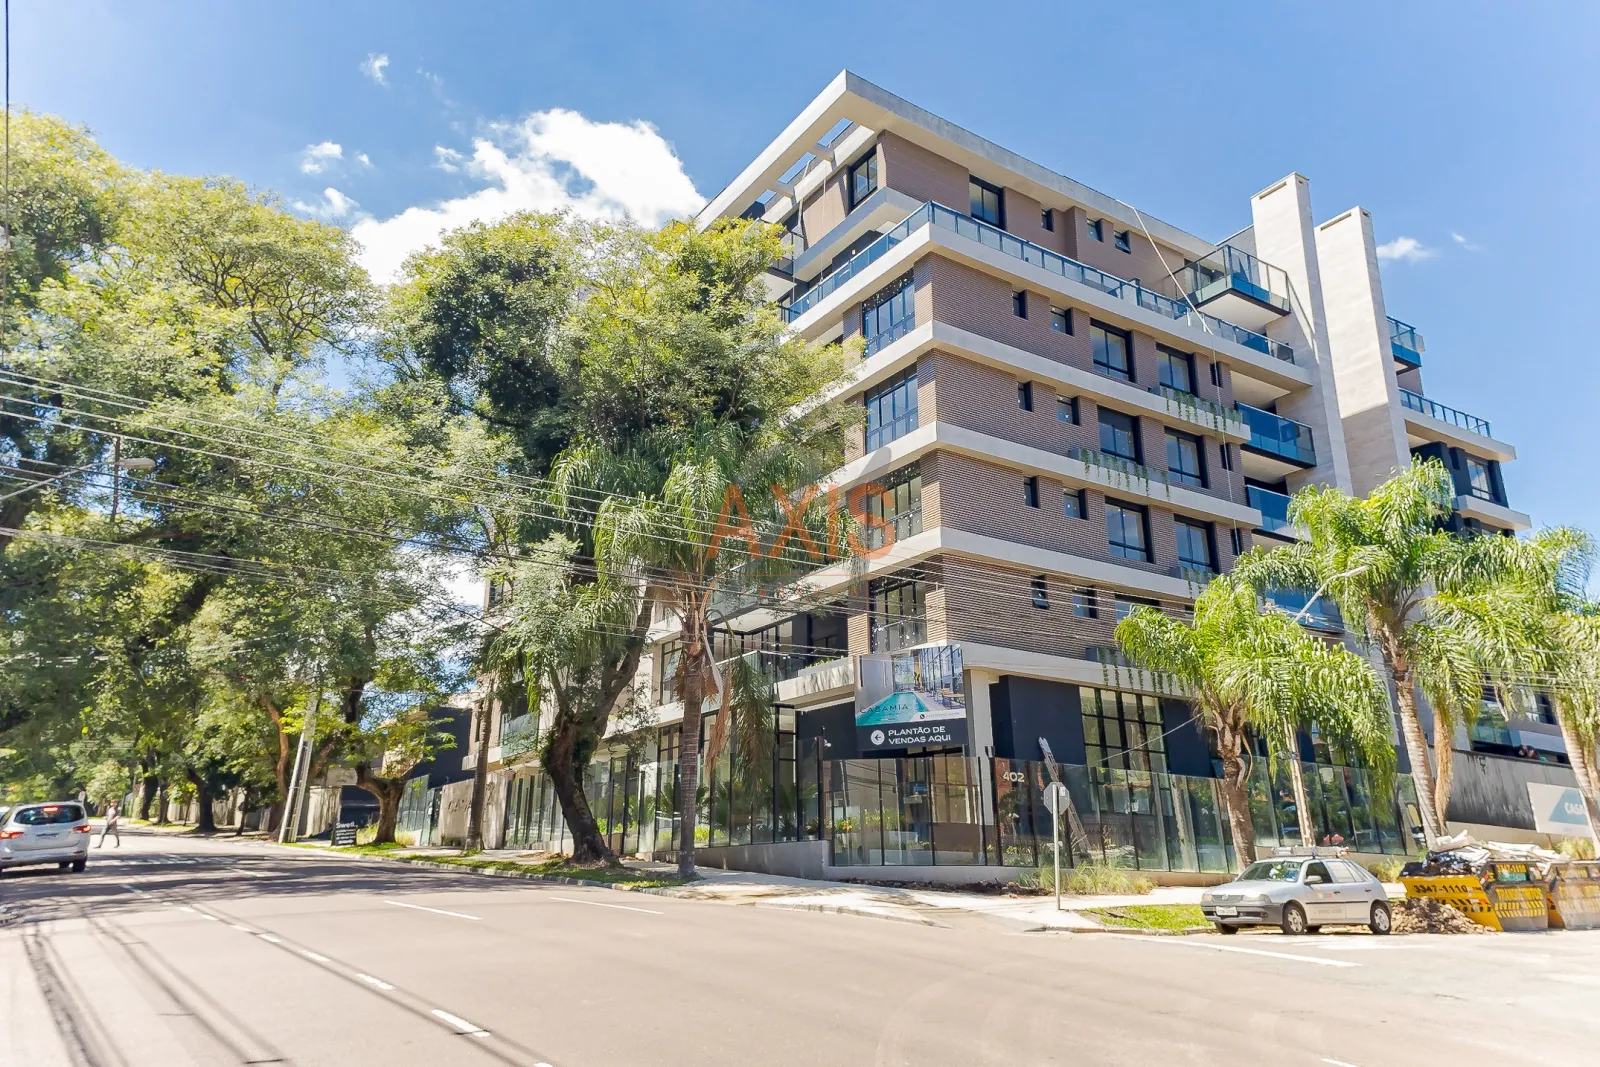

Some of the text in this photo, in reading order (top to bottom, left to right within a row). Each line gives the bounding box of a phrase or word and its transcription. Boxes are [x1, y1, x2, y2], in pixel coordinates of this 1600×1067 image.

[860, 704, 909, 714] CASAMIA
[888, 725, 946, 737] PLANTÃO DE
[888, 734, 951, 745] VENDAS AQUI
[1002, 771, 1025, 783] 402
[1413, 884, 1468, 894] 3347-1110
